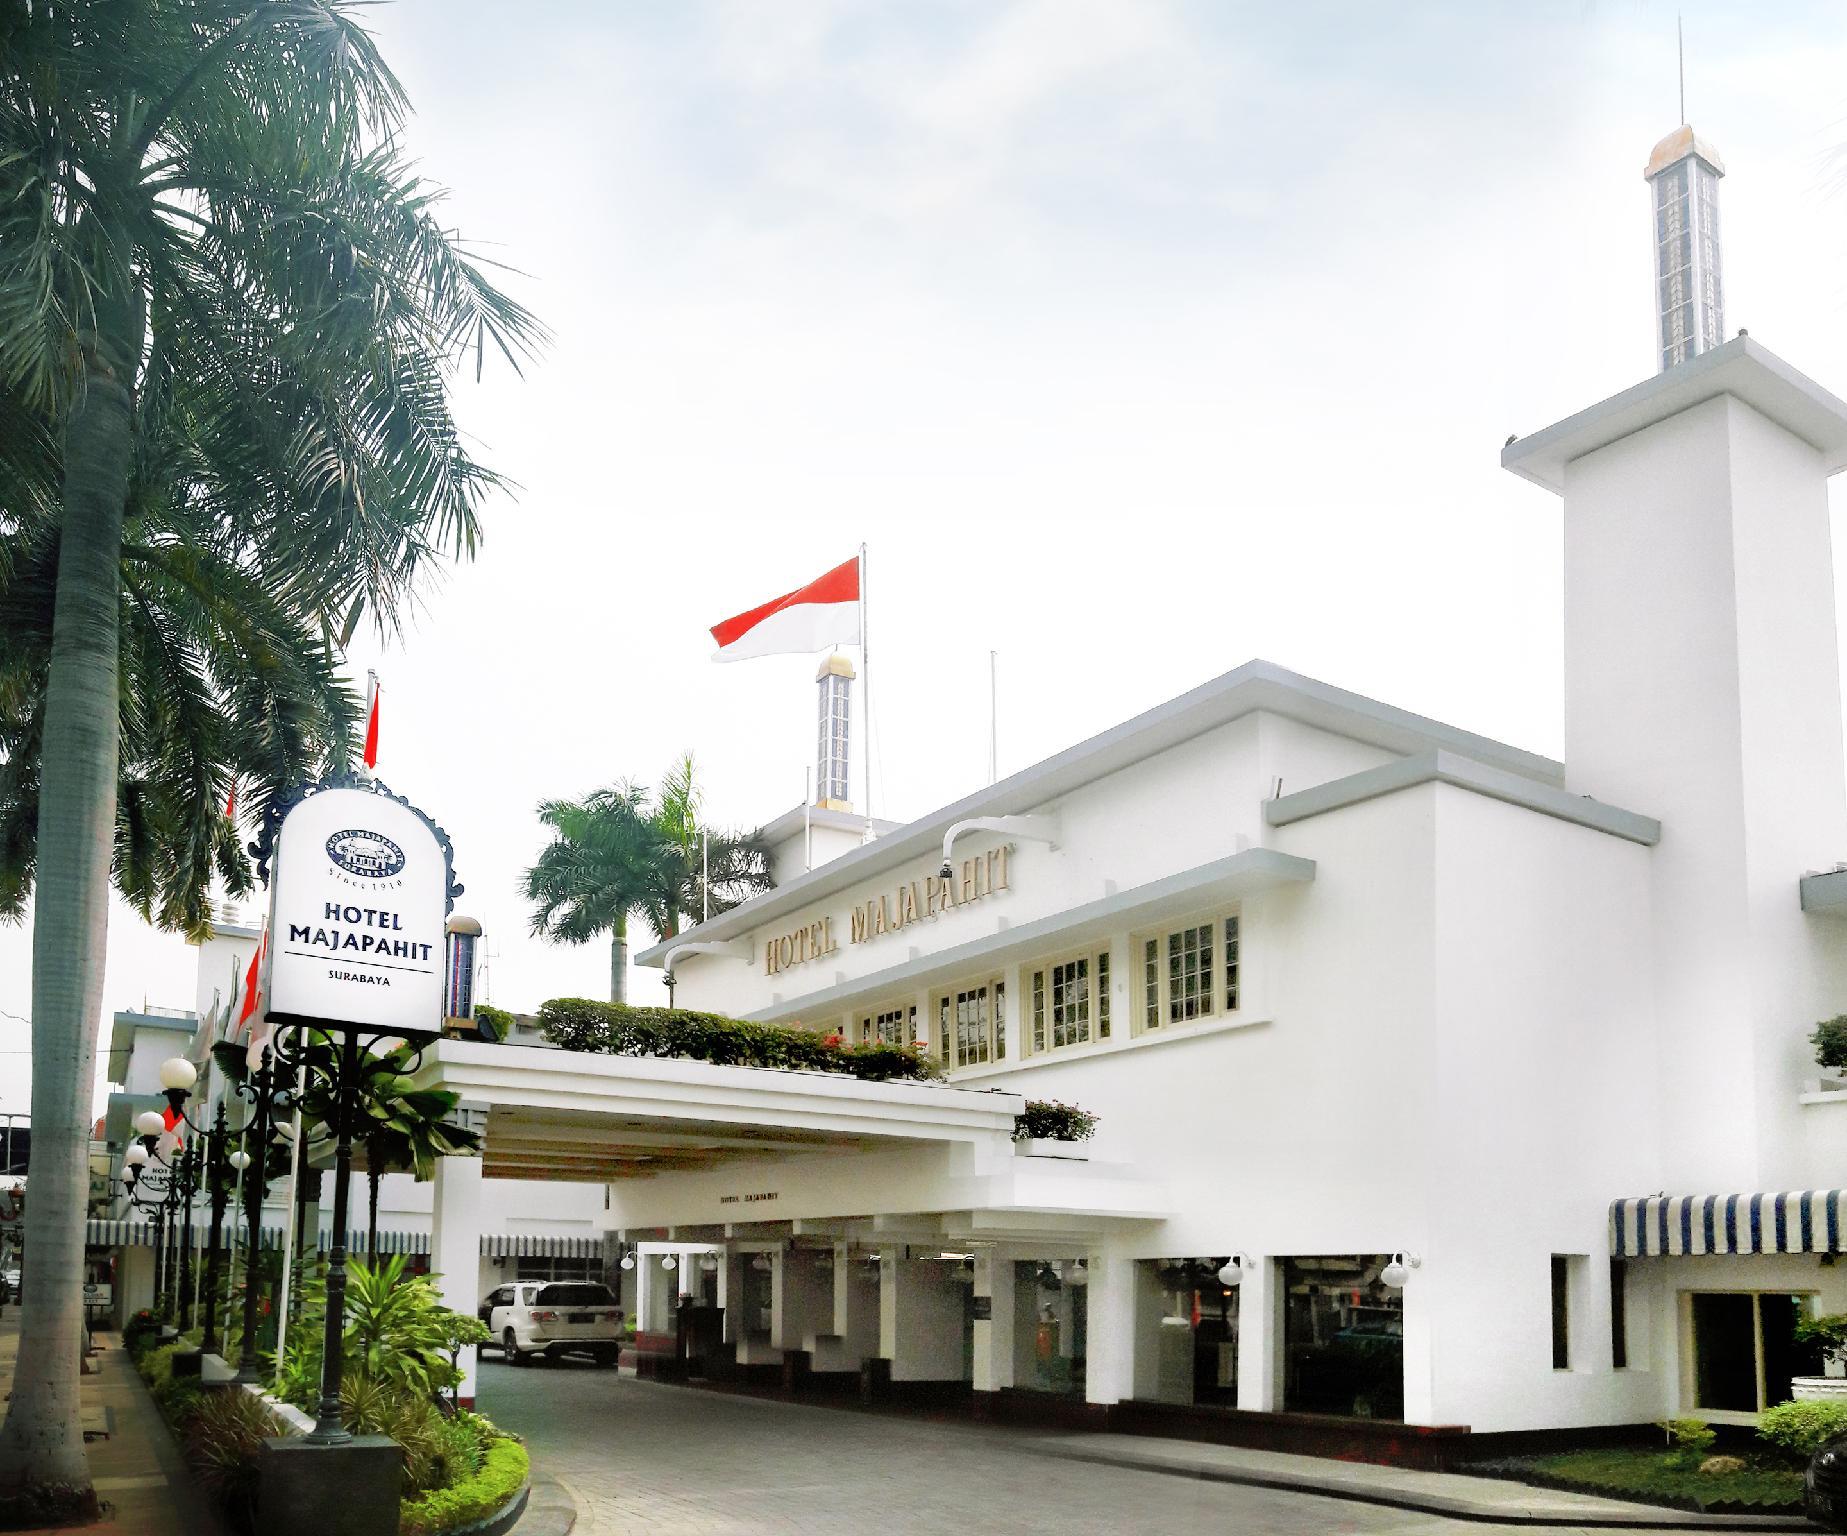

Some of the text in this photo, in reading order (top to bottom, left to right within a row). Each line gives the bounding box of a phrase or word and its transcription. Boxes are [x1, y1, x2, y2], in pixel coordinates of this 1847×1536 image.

[329, 867, 366, 889] Since
[324, 902, 403, 930] HOTEL
[765, 844, 1012, 976] HOTEL MAJAPAHIT
[289, 924, 433, 961] MAJAPAHIT
[328, 970, 391, 986] SURABAYA
